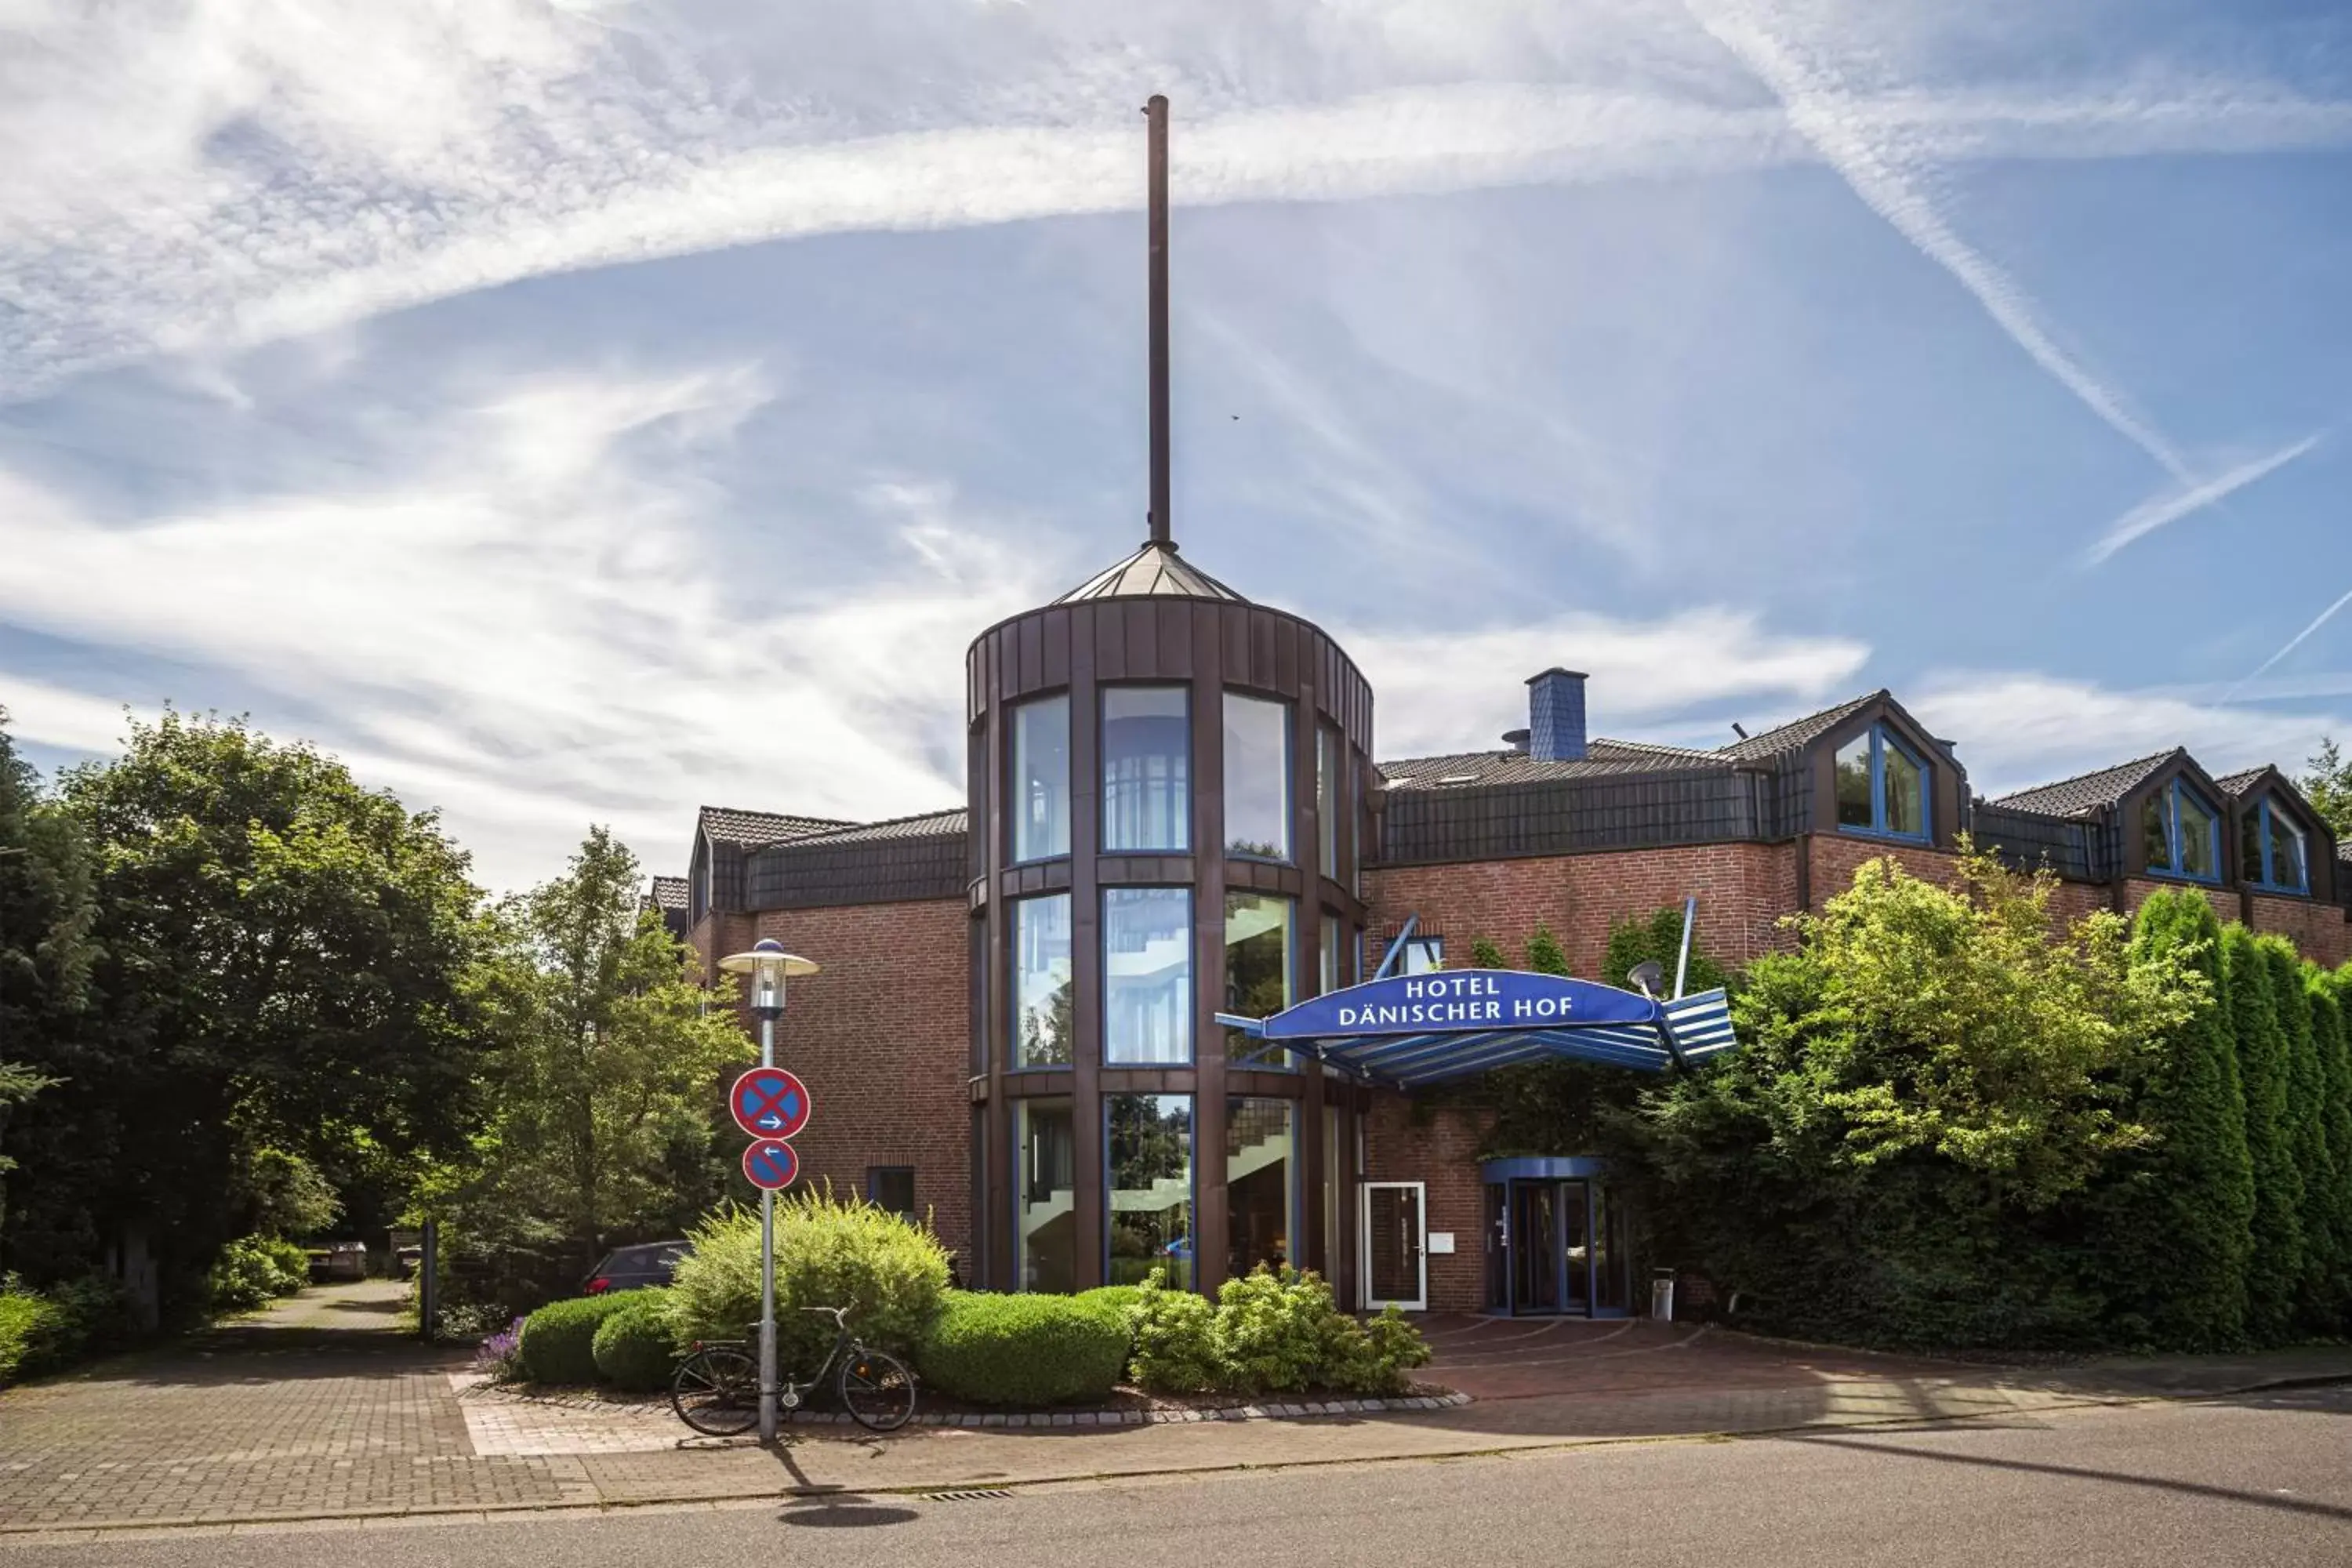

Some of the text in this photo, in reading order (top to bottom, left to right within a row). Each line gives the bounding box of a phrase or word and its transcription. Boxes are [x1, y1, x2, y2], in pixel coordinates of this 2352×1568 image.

[1406, 977, 1500, 998] HOTEL
[1339, 996, 1572, 1025] DÄNISCHER HOF
